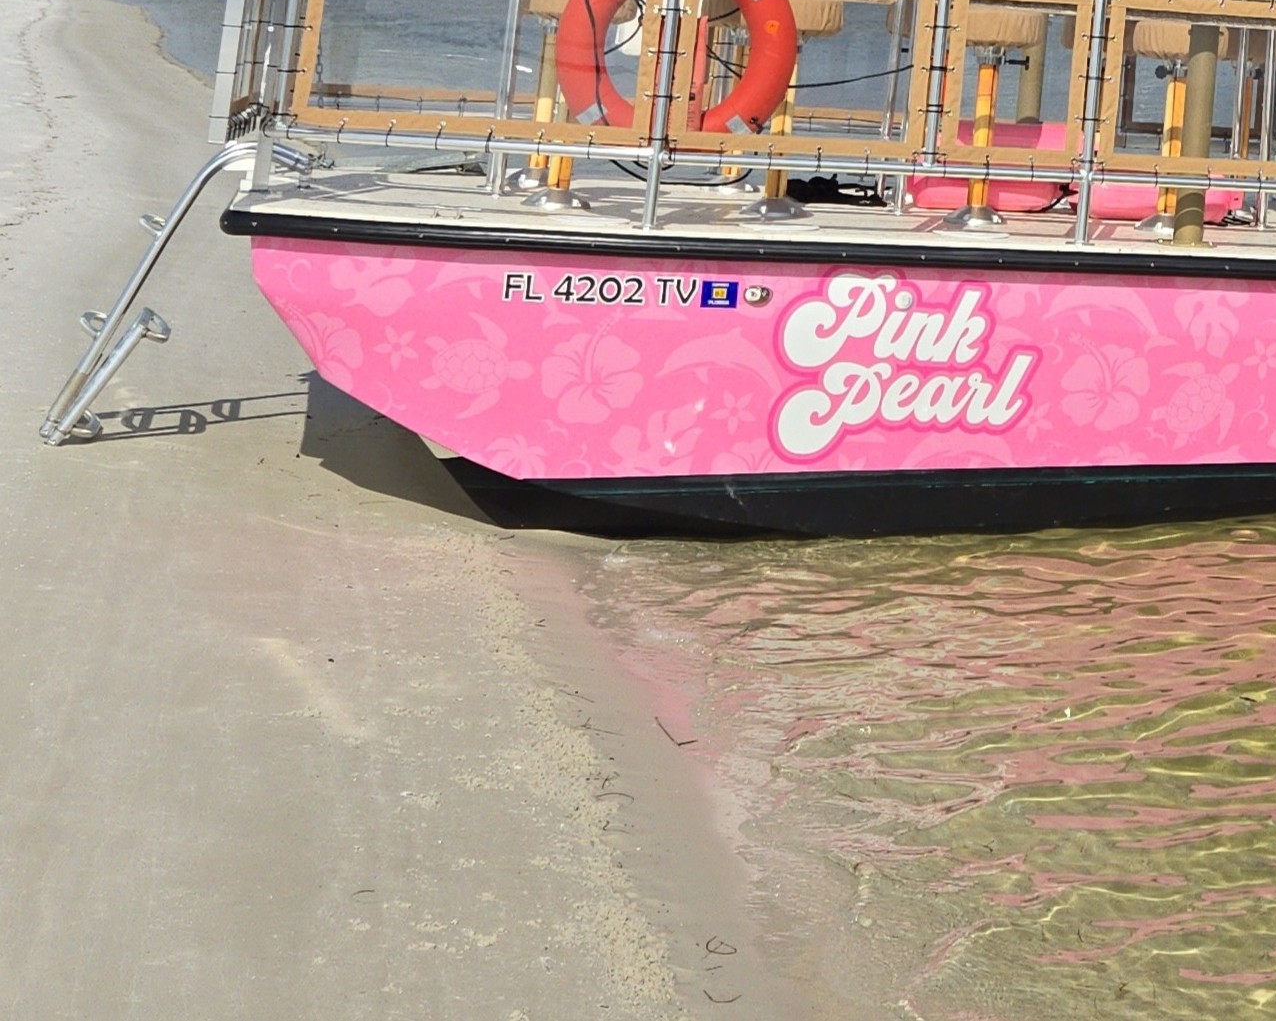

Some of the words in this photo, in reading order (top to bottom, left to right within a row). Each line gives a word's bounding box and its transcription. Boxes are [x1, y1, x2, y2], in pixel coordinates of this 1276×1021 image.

[503, 273, 543, 301] FL
[553, 275, 644, 304] 4202
[656, 277, 697, 305] TV
[783, 273, 986, 368] Pink
[777, 355, 1033, 455] Pearl
